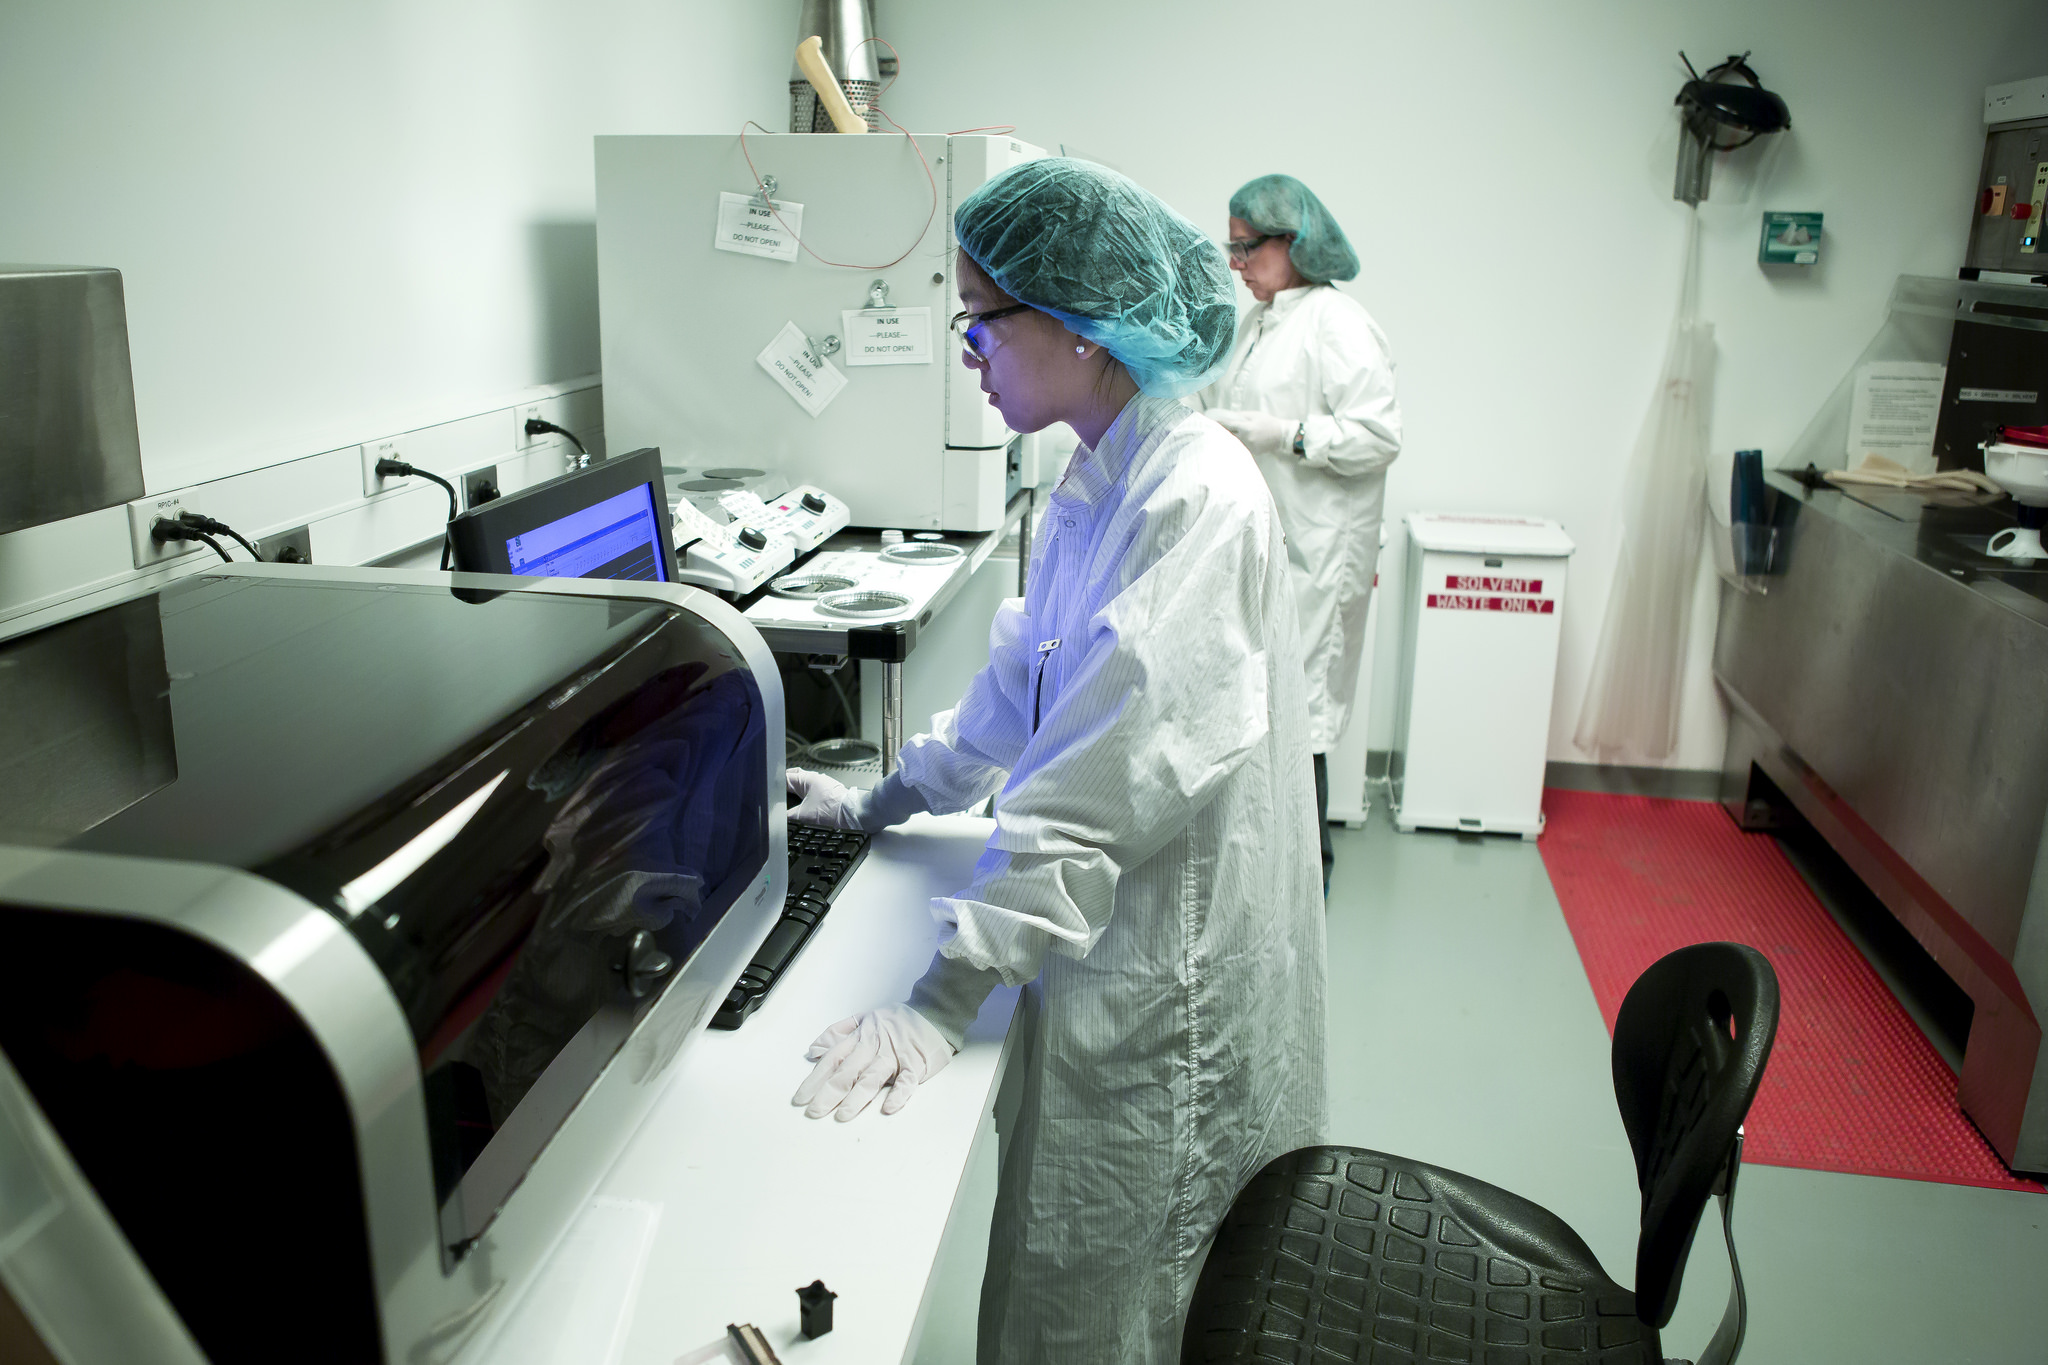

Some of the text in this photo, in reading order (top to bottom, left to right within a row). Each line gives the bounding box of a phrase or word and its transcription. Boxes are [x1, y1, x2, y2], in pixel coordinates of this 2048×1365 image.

[733, 233, 743, 241] DO
[760, 238, 781, 247] OPEN!
[803, 350, 810, 358] IN
[775, 360, 813, 397] DO NOT OPEN!
[1457, 576, 1533, 592] SOLVENT
[1436, 595, 1545, 613] WASTE ONLY
